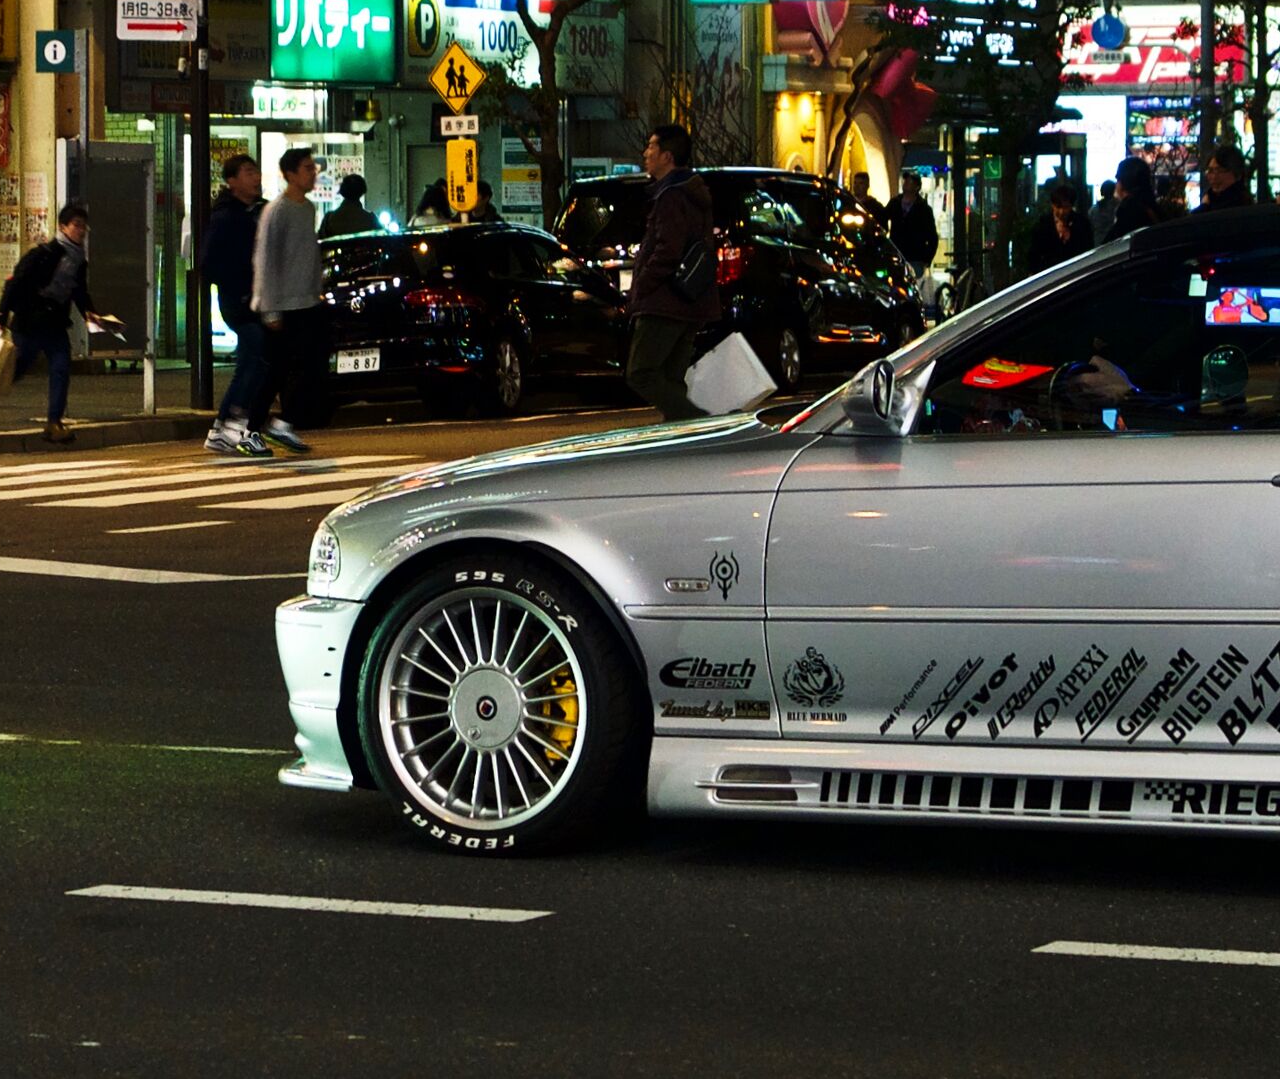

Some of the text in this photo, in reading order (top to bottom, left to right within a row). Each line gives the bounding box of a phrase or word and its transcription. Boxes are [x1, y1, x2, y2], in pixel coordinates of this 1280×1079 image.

[454, 569, 505, 584] 595
[658, 656, 757, 689] Eibach
[893, 658, 938, 717] Performance
[1074, 647, 1147, 736] FEDERAL
[1160, 643, 1250, 746] BILSTEIN
[787, 711, 847, 722] BLUE MERMAID
[400, 800, 516, 850] FEDERAL
